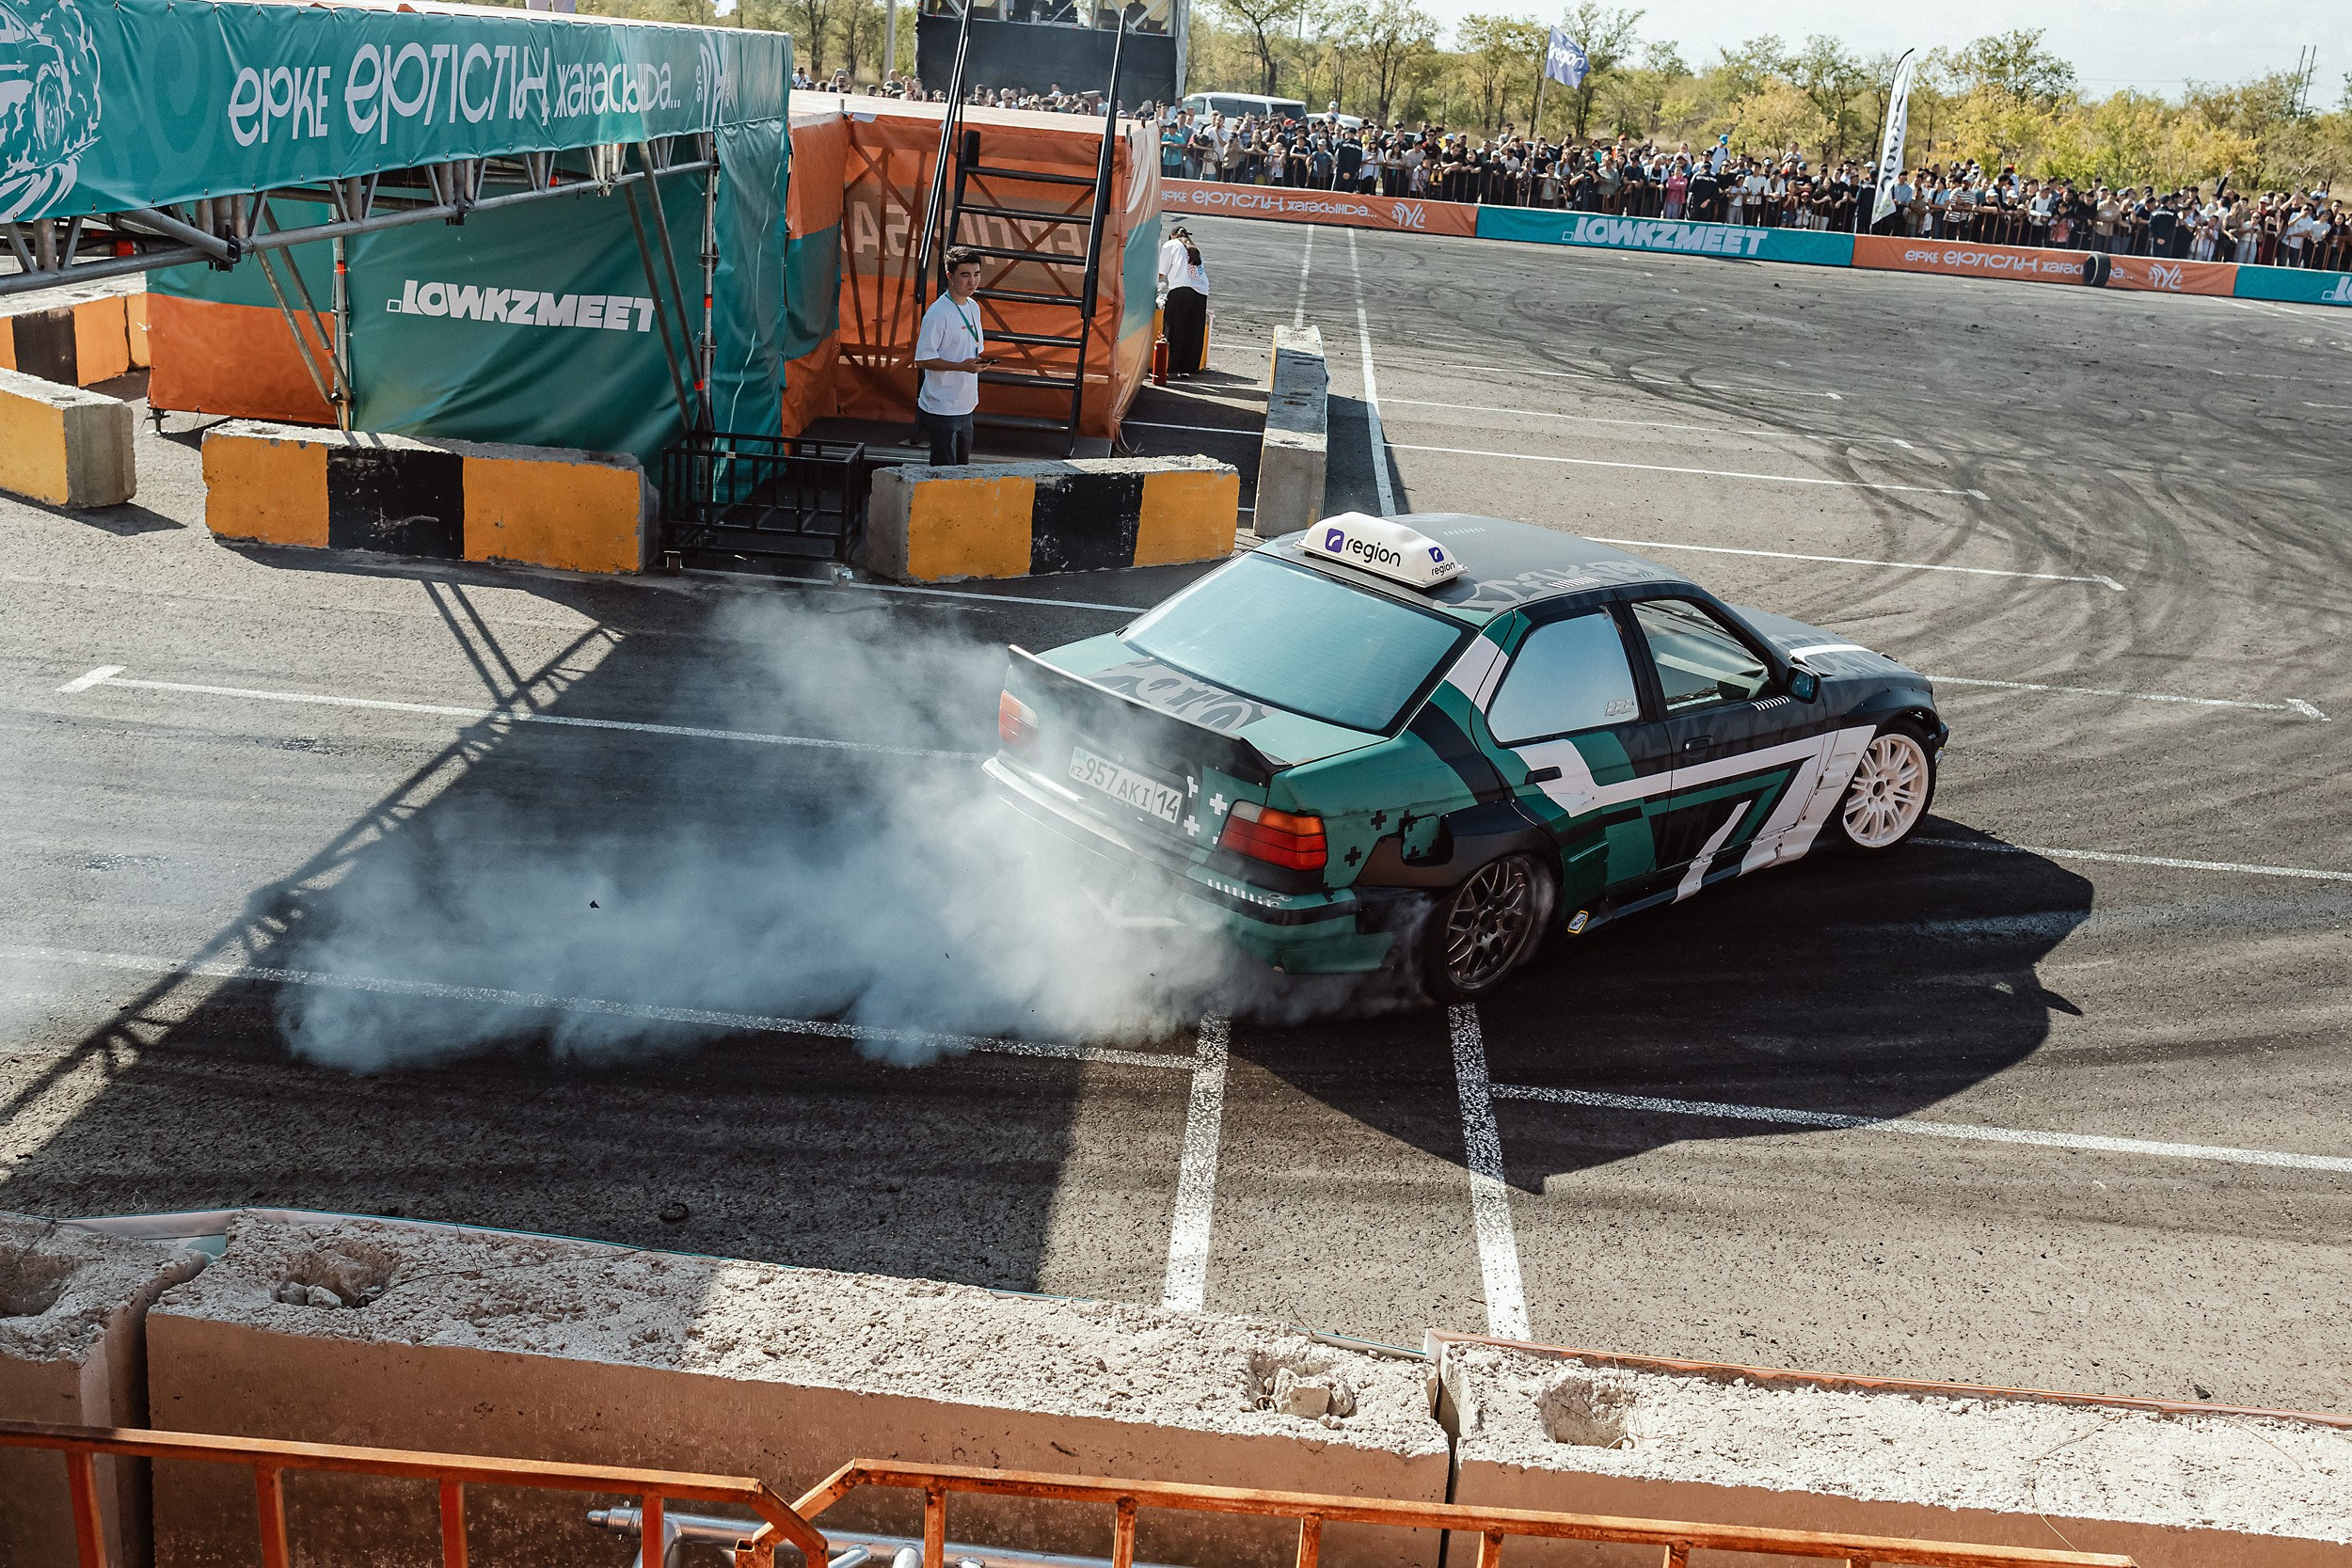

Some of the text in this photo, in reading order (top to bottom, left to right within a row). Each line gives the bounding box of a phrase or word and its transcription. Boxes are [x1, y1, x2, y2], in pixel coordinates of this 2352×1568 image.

[1572, 216, 1769, 256] LOWKZMEET
[401, 279, 656, 332] LOWKZMEET
[1345, 538, 1402, 567] region
[1431, 562, 1455, 577] region
[1070, 765, 1083, 778] KZ
[1084, 757, 1120, 791] 957
[1156, 790, 1179, 820] 14
